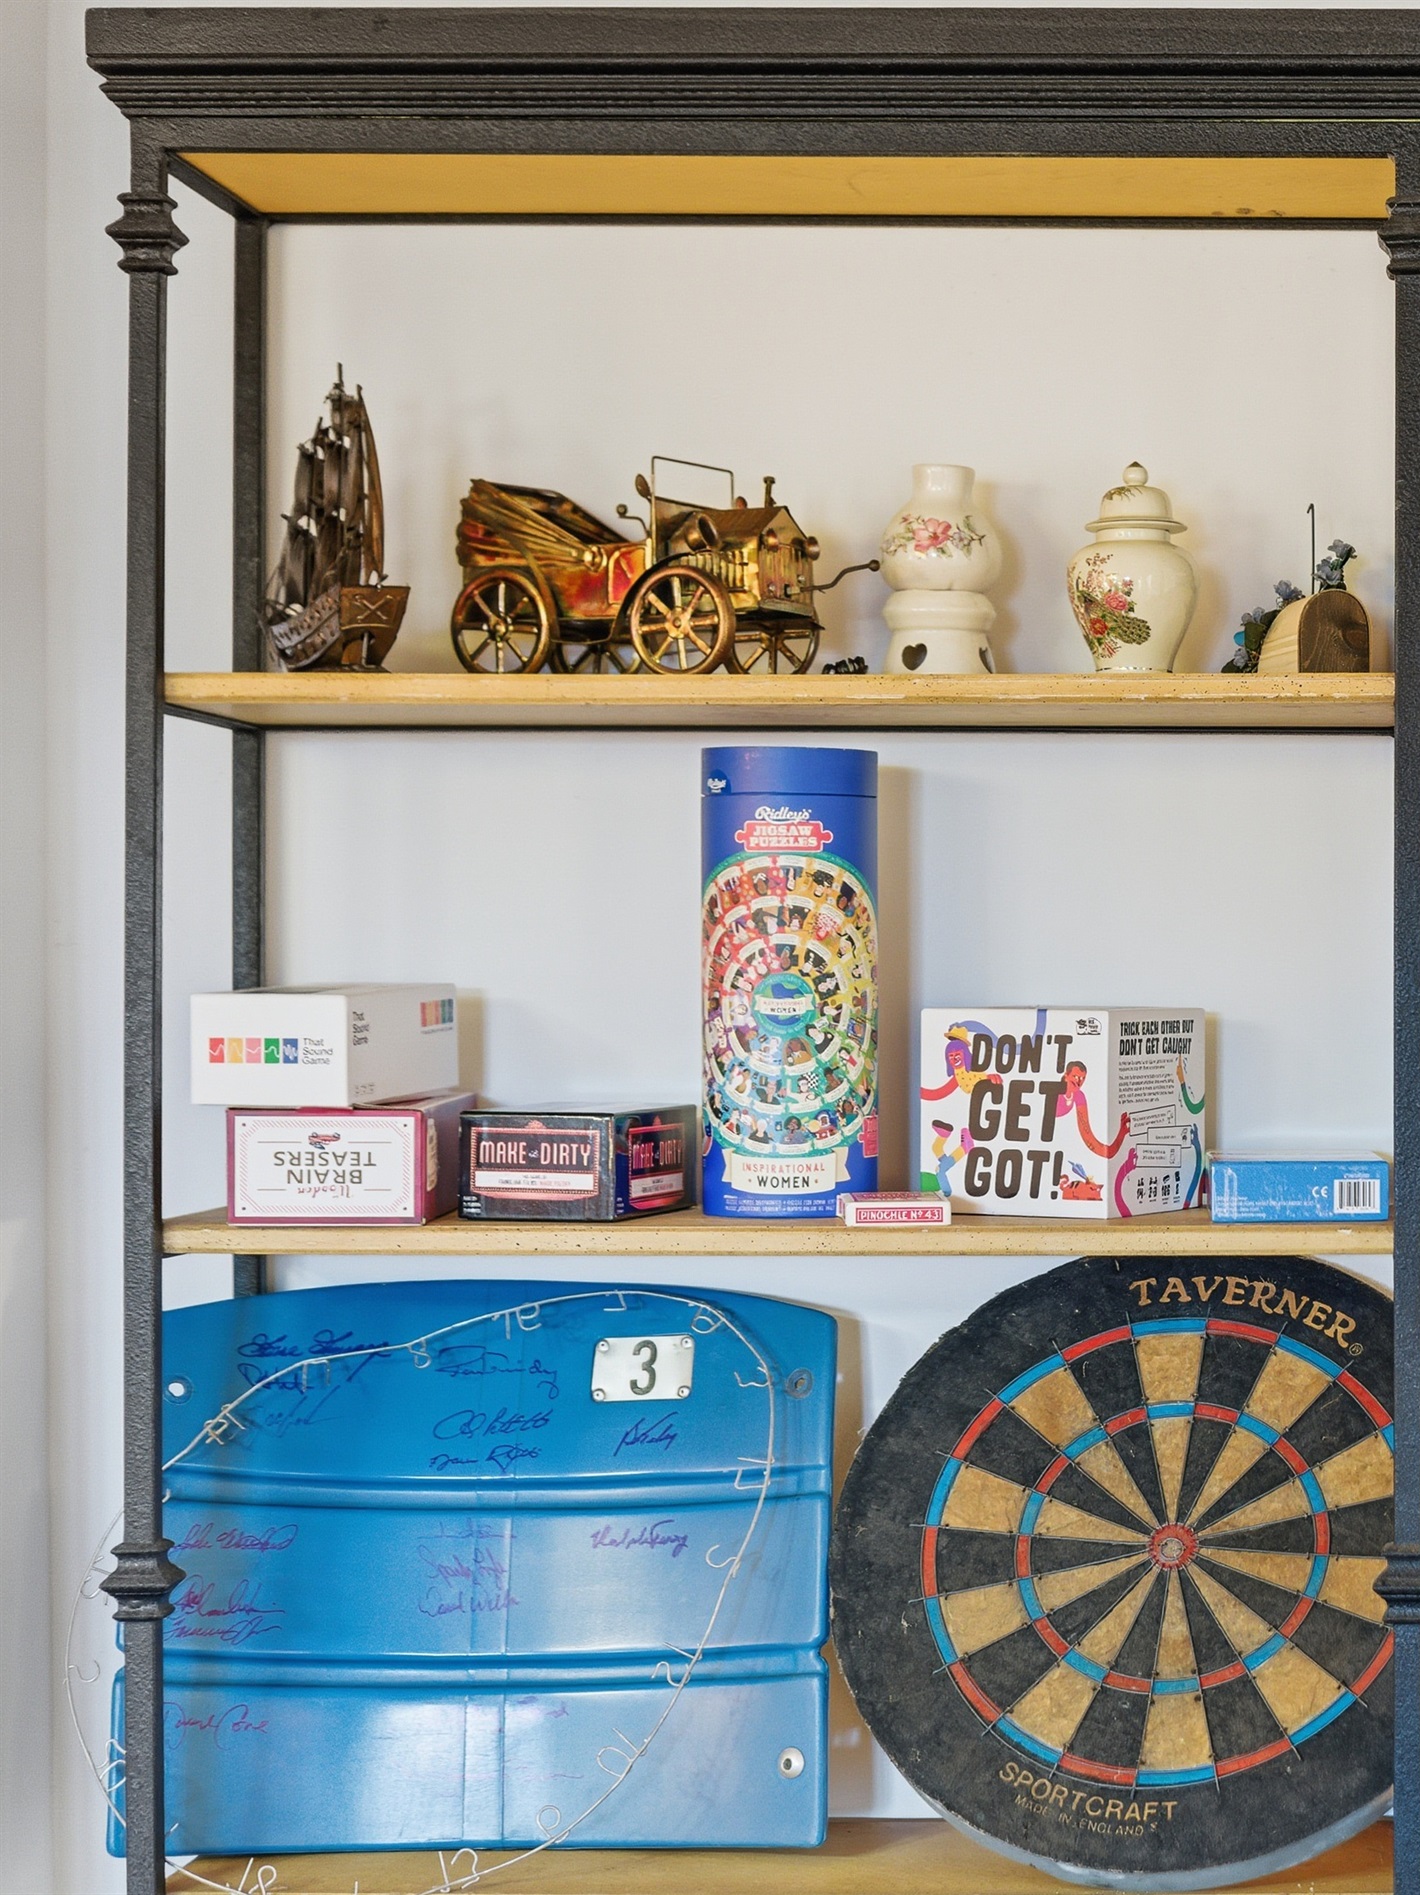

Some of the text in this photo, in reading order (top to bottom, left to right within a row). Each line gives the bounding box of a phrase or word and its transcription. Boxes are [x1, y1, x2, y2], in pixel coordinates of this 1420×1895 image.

[754, 805, 812, 825] Ridley's
[752, 825, 813, 836] JIGSAW
[749, 836, 818, 848] PUZZLES
[1120, 1019, 1194, 1037] TRICK EACH OTHER BUT
[303, 1037, 325, 1047] That
[1145, 1037, 1160, 1055] GET
[1162, 1036, 1192, 1055] CAUGHT
[301, 1056, 331, 1065] Game
[302, 1047, 334, 1056] Sound
[971, 1033, 1075, 1075] DON'T
[968, 1079, 1068, 1143] GET
[273, 1151, 377, 1167] TEASERS
[479, 1141, 591, 1167] MAKE DIRTY
[741, 1161, 826, 1174] INSPIRATIONAL
[964, 1147, 1064, 1201] GOT!
[286, 1169, 363, 1185] BRAIN
[757, 1175, 811, 1189] WOMEN
[860, 1210, 908, 1221] PINOCHLE
[1129, 1275, 1357, 1349] TAVERNER
[629, 1340, 658, 1395] 3
[999, 1761, 1178, 1823] SPORTCRAFT
[1014, 1794, 1050, 1817] MADE
[1058, 1812, 1074, 1827] IN
